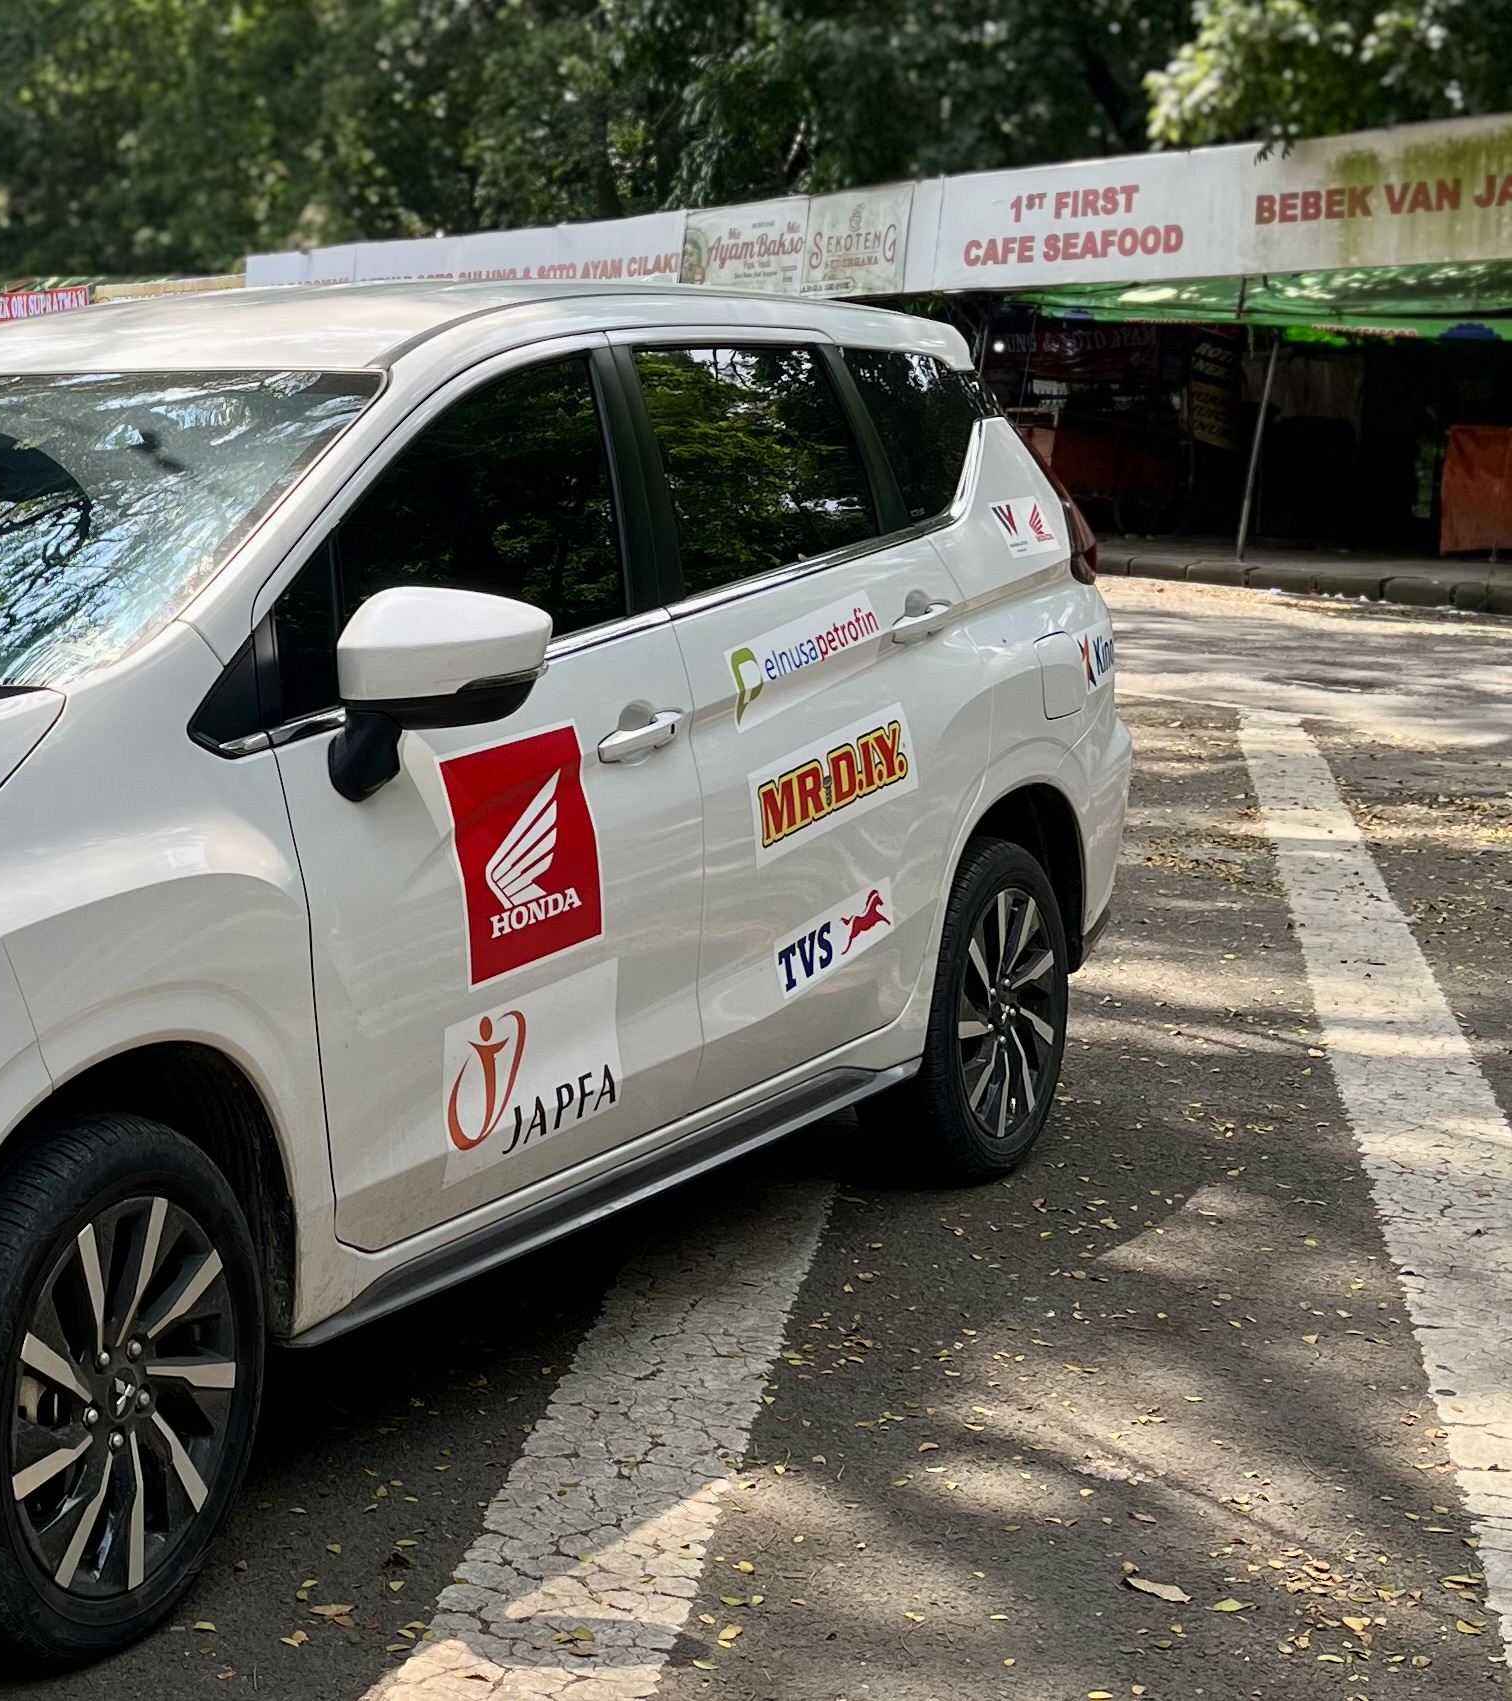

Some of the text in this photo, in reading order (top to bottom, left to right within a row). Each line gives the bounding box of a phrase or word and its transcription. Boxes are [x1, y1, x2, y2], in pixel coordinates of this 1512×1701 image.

[1010, 184, 1140, 223] 1ST FIRST
[1254, 185, 1375, 226] BEBEK
[1384, 177, 1463, 216] VAN
[707, 232, 807, 270] Ayam Bakso
[809, 223, 898, 270] SEKOTENG
[824, 255, 879, 269] SEDERHANA
[963, 224, 1185, 267] CAFE SEAFOOD
[581, 258, 623, 279] AYAM
[11, 294, 28, 318] ORI
[28, 289, 86, 317] SUPRATMAN
[489, 887, 583, 939] HONDA
[778, 921, 833, 992] TVS
[502, 1063, 617, 1156] JAPFA
